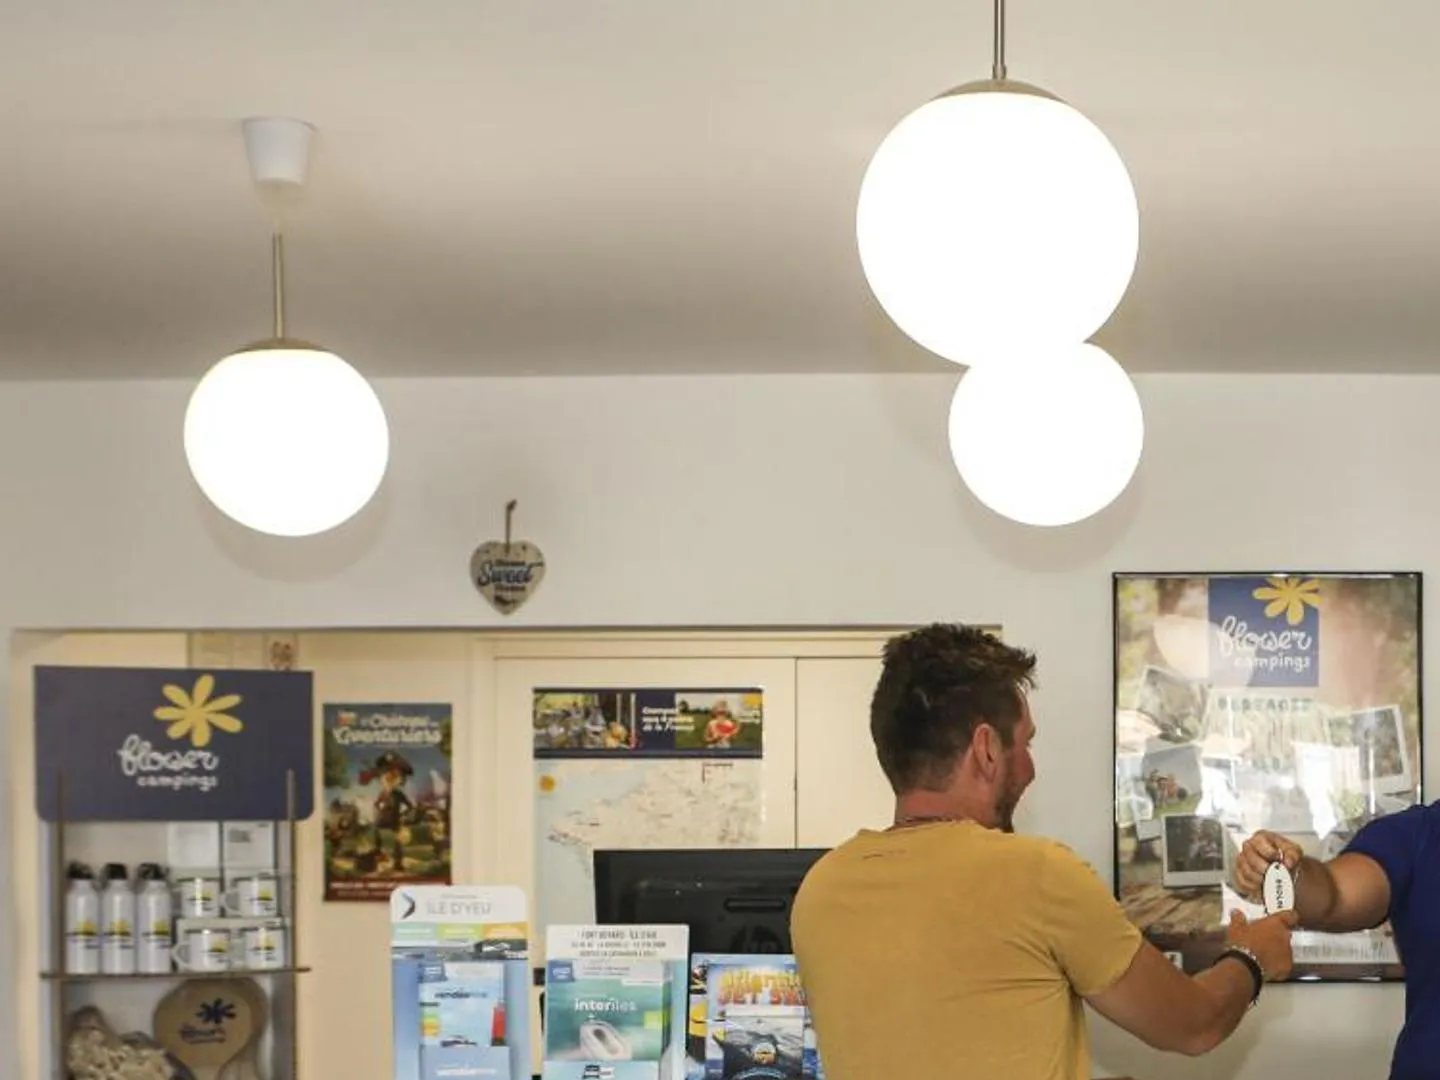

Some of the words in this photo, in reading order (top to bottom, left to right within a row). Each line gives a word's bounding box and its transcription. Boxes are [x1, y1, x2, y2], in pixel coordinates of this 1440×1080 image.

[1218, 615, 1313, 656] flower
[1234, 649, 1312, 673] campings
[117, 734, 219, 776] flower
[137, 774, 219, 792] campings
